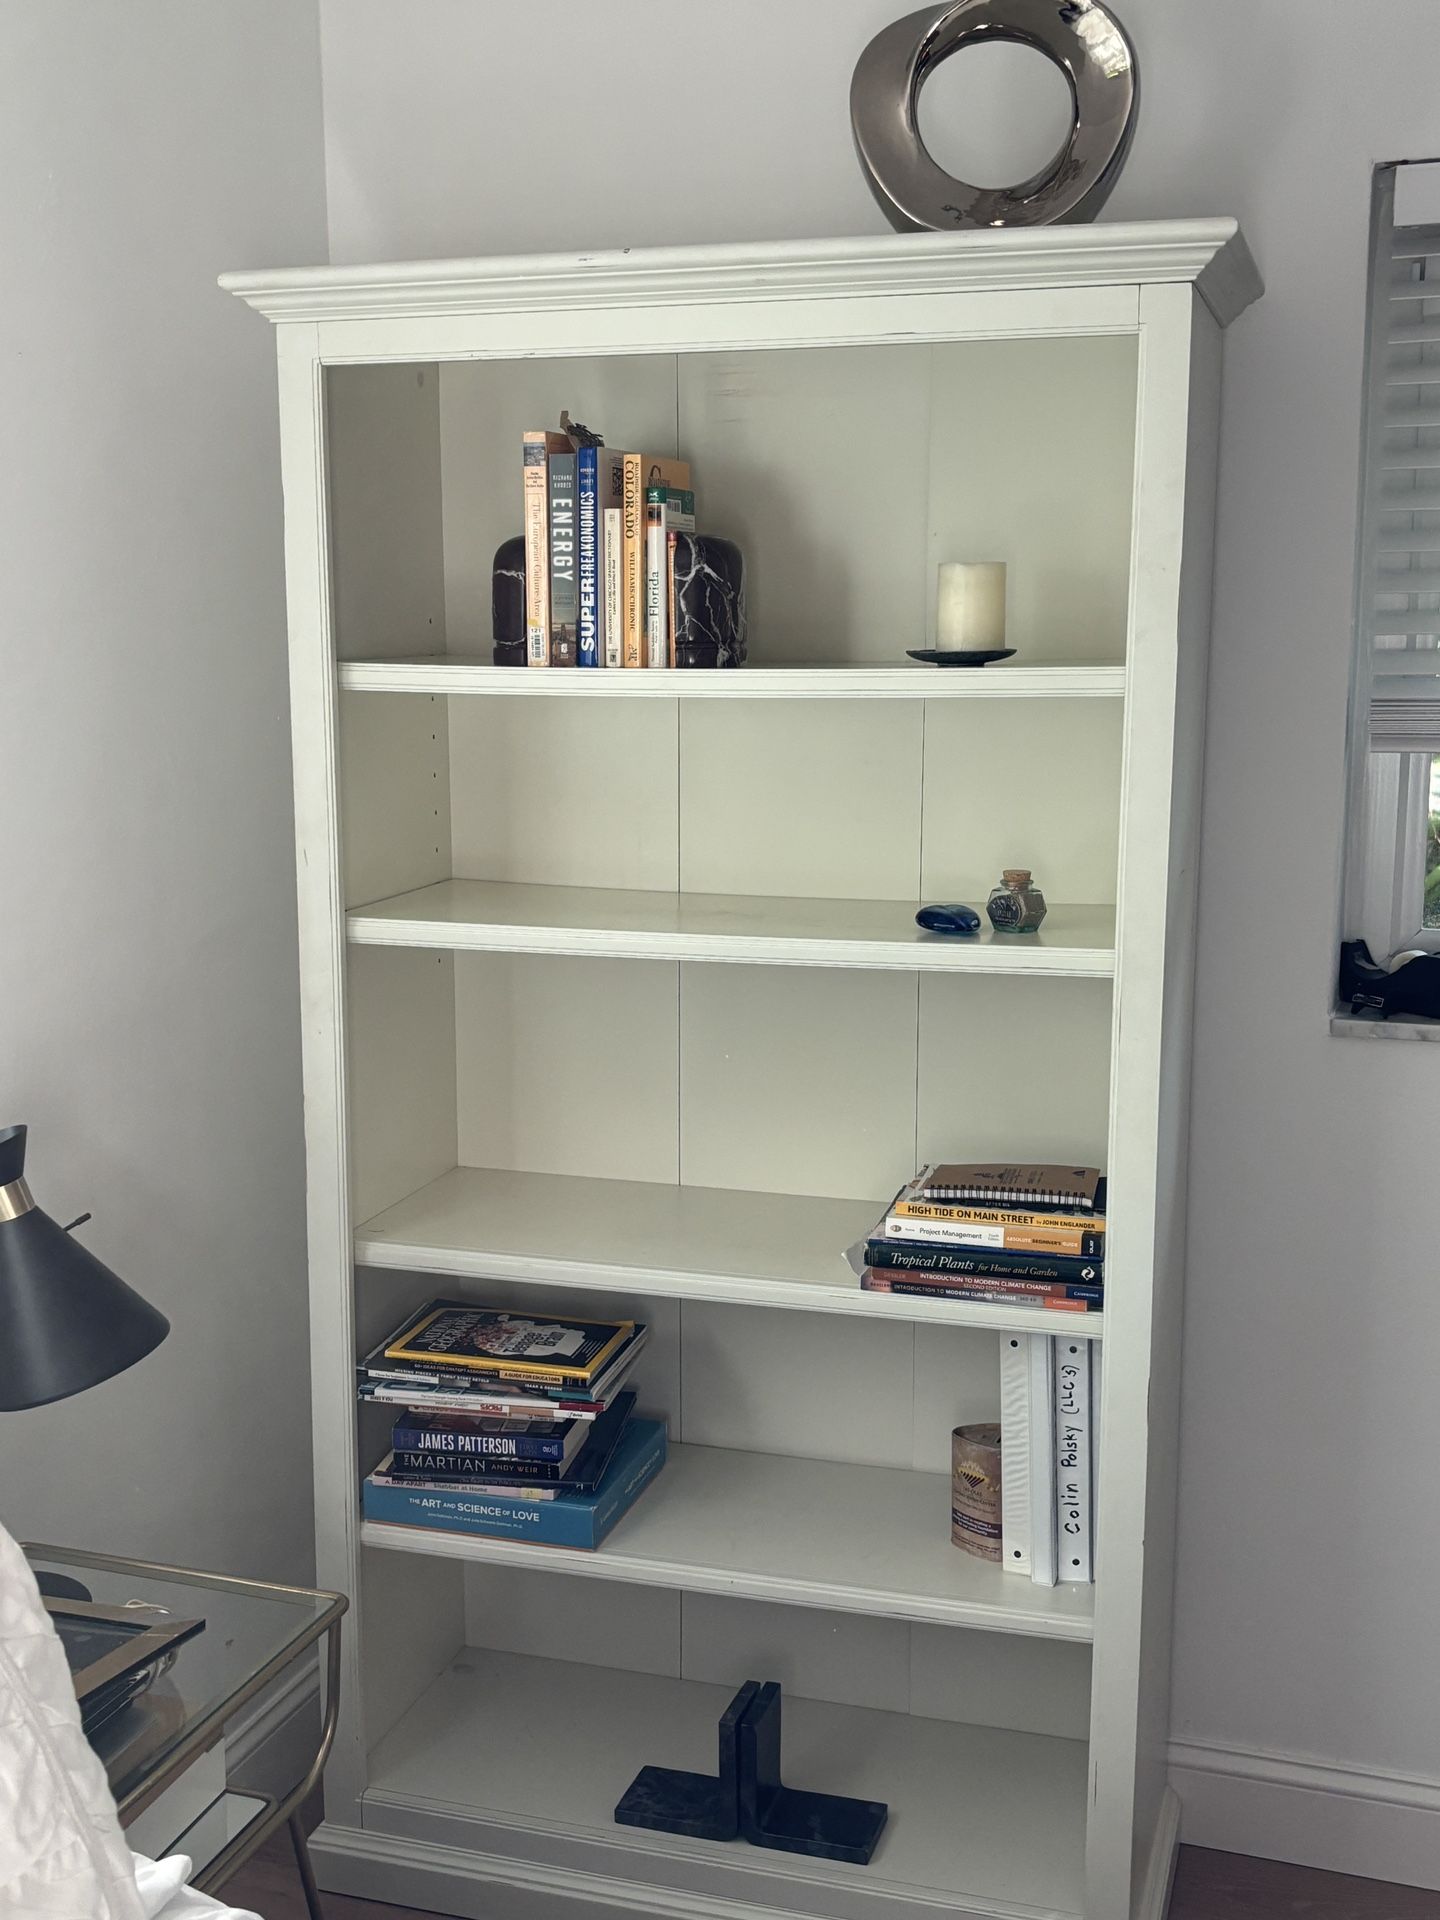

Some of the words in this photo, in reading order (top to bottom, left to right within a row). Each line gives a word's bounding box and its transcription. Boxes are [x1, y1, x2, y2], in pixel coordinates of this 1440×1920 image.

[625, 460, 635, 539] COLORADO
[531, 521, 542, 562] European
[552, 498, 574, 582] ENERGY
[580, 491, 595, 652] SUPERFREAKONOMICS
[649, 572, 659, 616] Florida
[908, 1205, 931, 1215] HIGH
[934, 1208, 954, 1218] TIDE
[957, 1210, 971, 1219] ON
[974, 1212, 998, 1221] MAIN
[1000, 1214, 1034, 1224] STREET
[920, 1228, 940, 1236] Project
[942, 1230, 982, 1239] Management
[891, 1252, 937, 1268] Tropical
[938, 1256, 974, 1270] Plants
[977, 1262, 988, 1272] for
[990, 1264, 1012, 1273] Home
[1013, 1266, 1029, 1274] and
[1030, 1266, 1058, 1276] Garden
[894, 1284, 936, 1293] INTRODUCTION
[971, 1290, 992, 1299] CLIMATE
[920, 1273, 963, 1282] INTRODUCTION
[974, 1277, 1000, 1285] MODERN
[1000, 1279, 1025, 1289] CLIMATE
[1027, 1283, 1051, 1291] CHANGE
[416, 1316, 458, 1343] NATIONAL
[428, 1312, 484, 1351] GEOGRAPHIC
[1060, 1365, 1080, 1414] (LLC's)
[418, 1433, 454, 1450] JAMES
[458, 1436, 516, 1455] PATTERSON
[1061, 1426, 1083, 1467] Polsky
[411, 1455, 485, 1472] MARTIAN
[422, 1498, 441, 1508] ART
[457, 1503, 501, 1516] SCIENCE
[513, 1510, 540, 1522] LOVE
[1064, 1483, 1080, 1534] Colin
